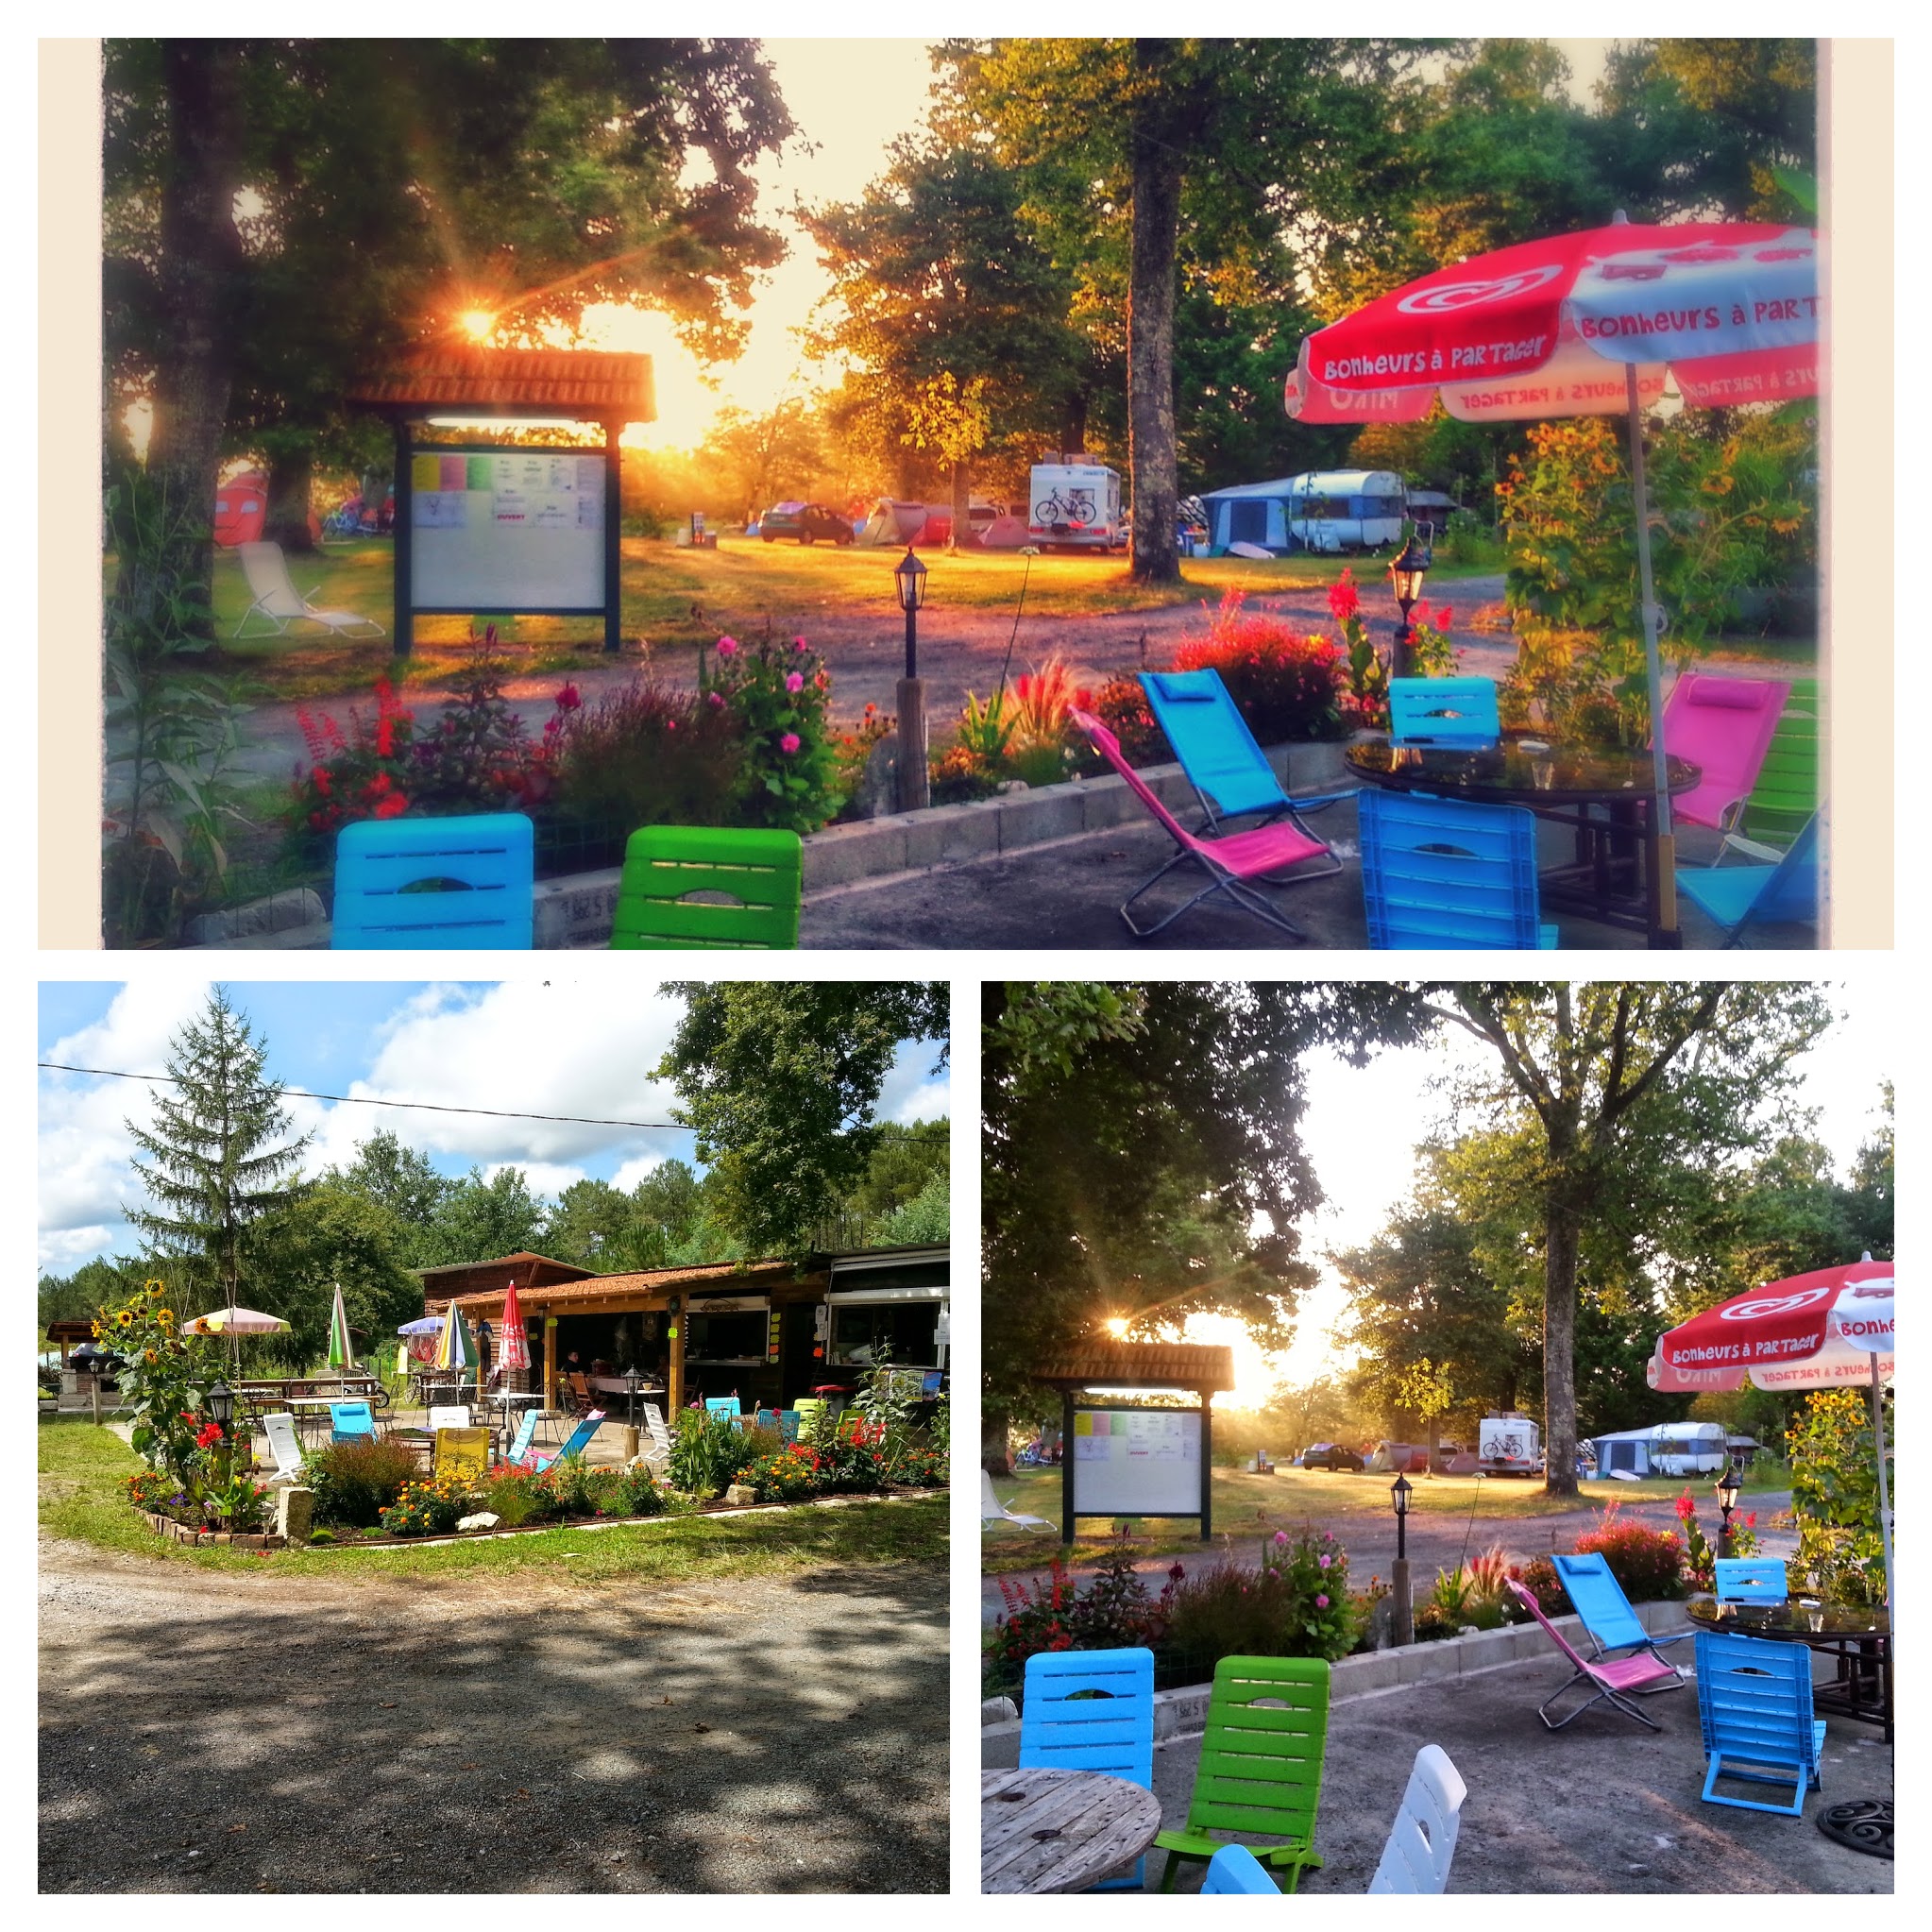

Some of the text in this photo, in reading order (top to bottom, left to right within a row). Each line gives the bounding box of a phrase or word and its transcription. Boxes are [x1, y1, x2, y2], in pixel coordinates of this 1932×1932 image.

[1731, 303, 1746, 326] à
[1431, 348, 1443, 369] à
[1742, 1343, 1751, 1357] à
